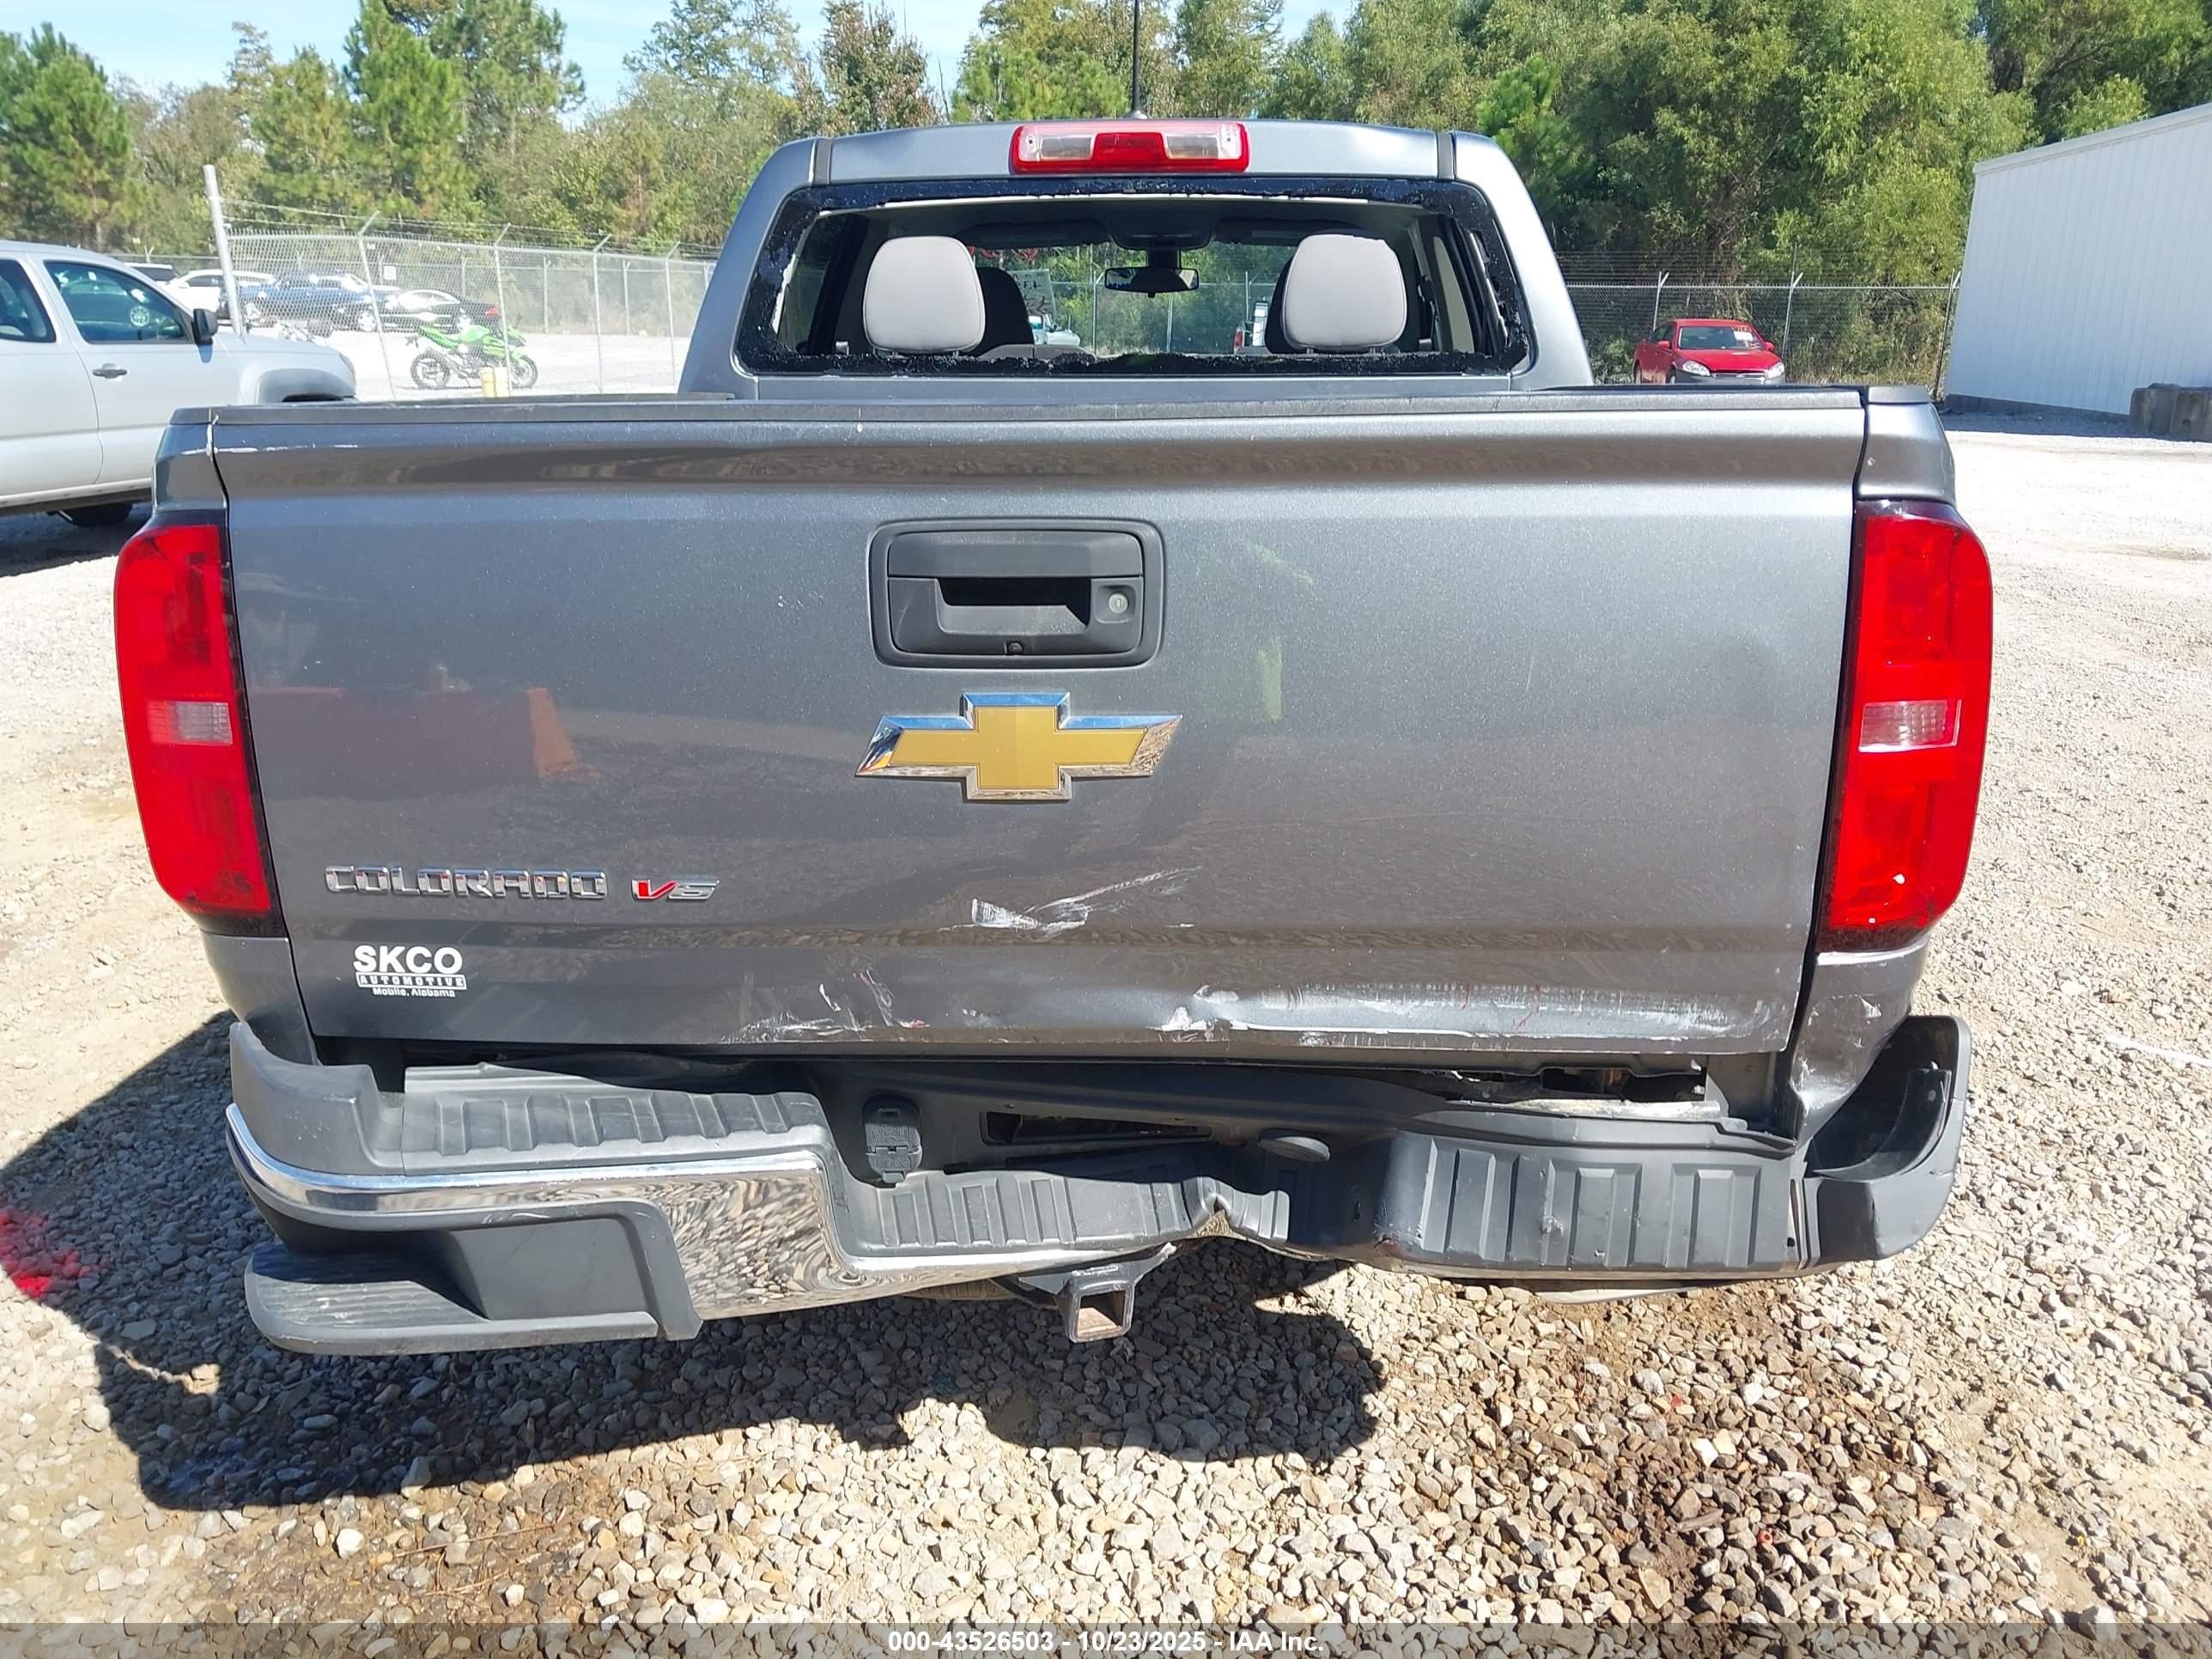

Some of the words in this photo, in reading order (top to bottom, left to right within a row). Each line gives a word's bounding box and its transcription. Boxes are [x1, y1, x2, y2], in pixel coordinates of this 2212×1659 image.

[325, 866, 608, 900] COLORADO
[632, 878, 720, 901] V6
[353, 945, 463, 975] SKCO
[360, 975, 464, 987] AUTOMOTIVE
[373, 988, 410, 996] Mobile,
[411, 988, 456, 998] Alabama
